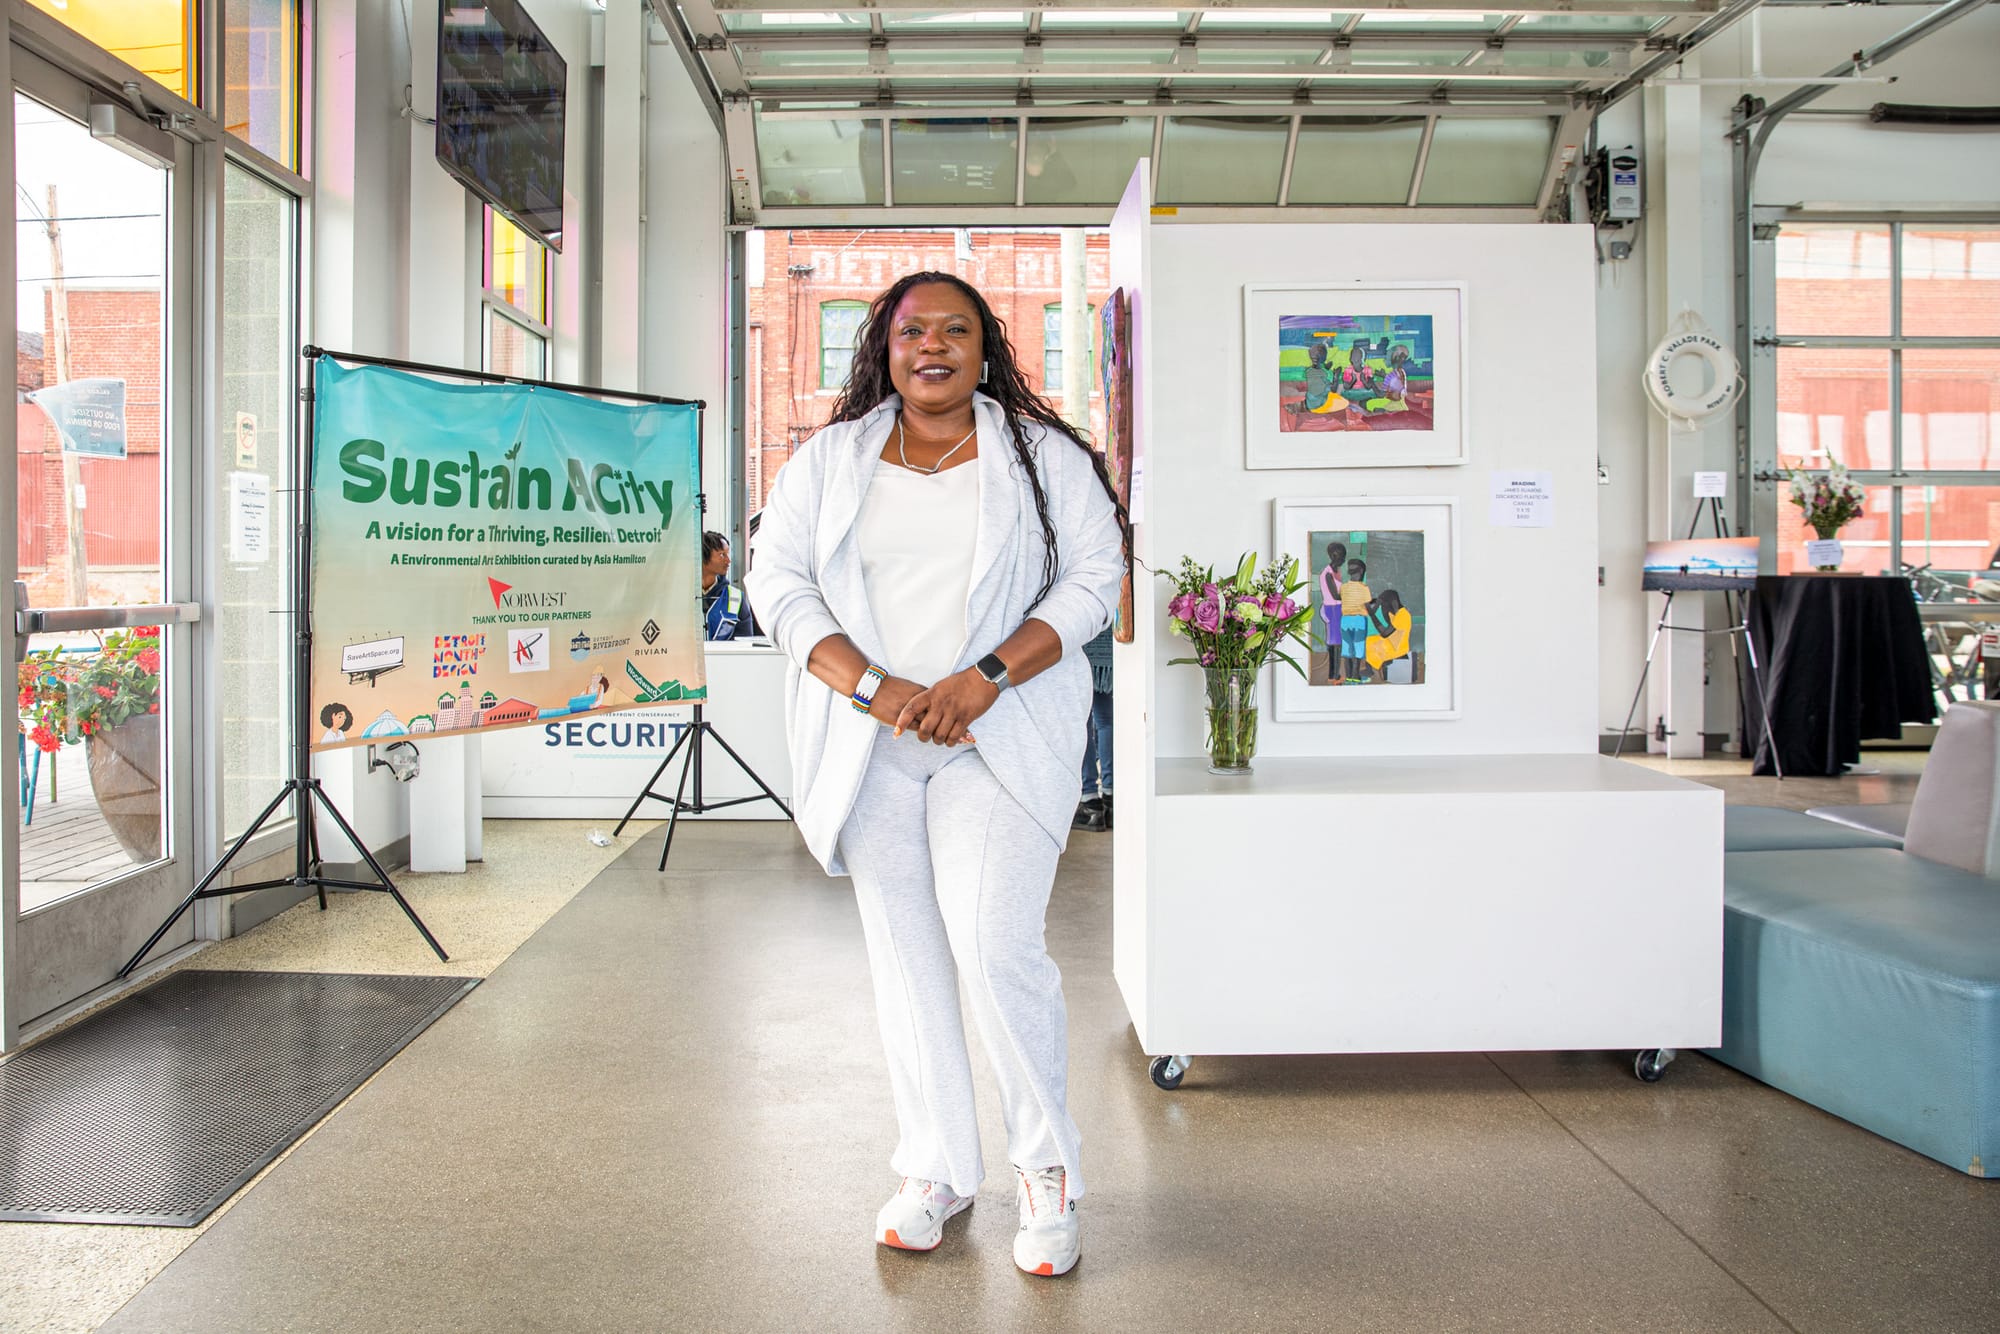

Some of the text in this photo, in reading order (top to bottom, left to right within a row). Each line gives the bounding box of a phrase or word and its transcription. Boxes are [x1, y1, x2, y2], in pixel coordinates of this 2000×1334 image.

[1666, 335, 1698, 353] VALADE
[1700, 336, 1722, 351] PARK
[1659, 364, 1675, 398] ROBERT
[339, 439, 552, 511] Sustain
[365, 521, 662, 547] A vision for a Thriving, Resilient Detroit
[390, 553, 646, 567] A Environmental Art Exhibition curated by Asia Hamilton
[502, 591, 567, 608] NORWEST
[472, 610, 592, 624] THANK YOU TO OUR PARTNERS
[434, 633, 487, 649] DETROIT
[347, 648, 400, 661] SaveArtSpace.org
[433, 648, 479, 664] MONTH
[634, 648, 668, 656] RIVIAN
[433, 662, 478, 678] DESIGN
[627, 663, 658, 697] Woodward
[545, 722, 706, 748] SECURIT
